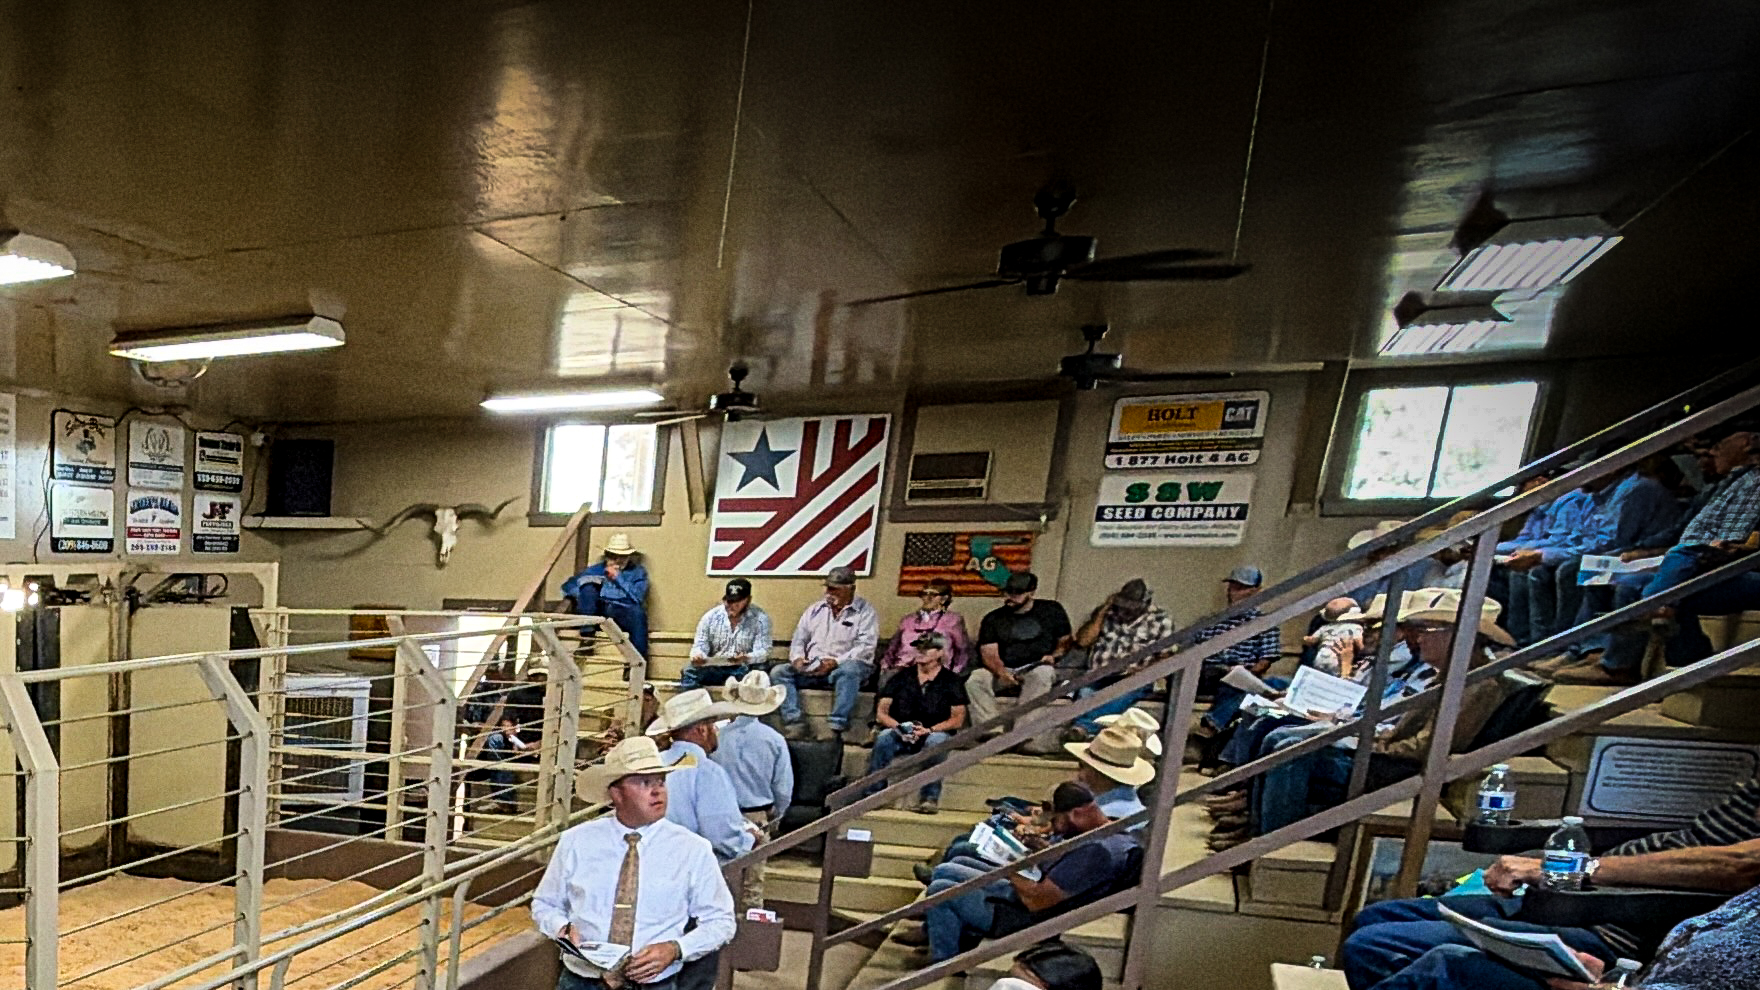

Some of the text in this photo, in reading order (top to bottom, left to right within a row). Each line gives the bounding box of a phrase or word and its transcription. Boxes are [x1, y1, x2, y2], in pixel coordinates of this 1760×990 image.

[1224, 406, 1254, 422] CAT
[1116, 456, 1122, 466] 1
[1128, 456, 1160, 466] 877
[1165, 454, 1204, 464] Holt
[1226, 452, 1250, 462] AG
[1103, 506, 1240, 520] SEED COMPANY
[965, 556, 998, 572] AG
